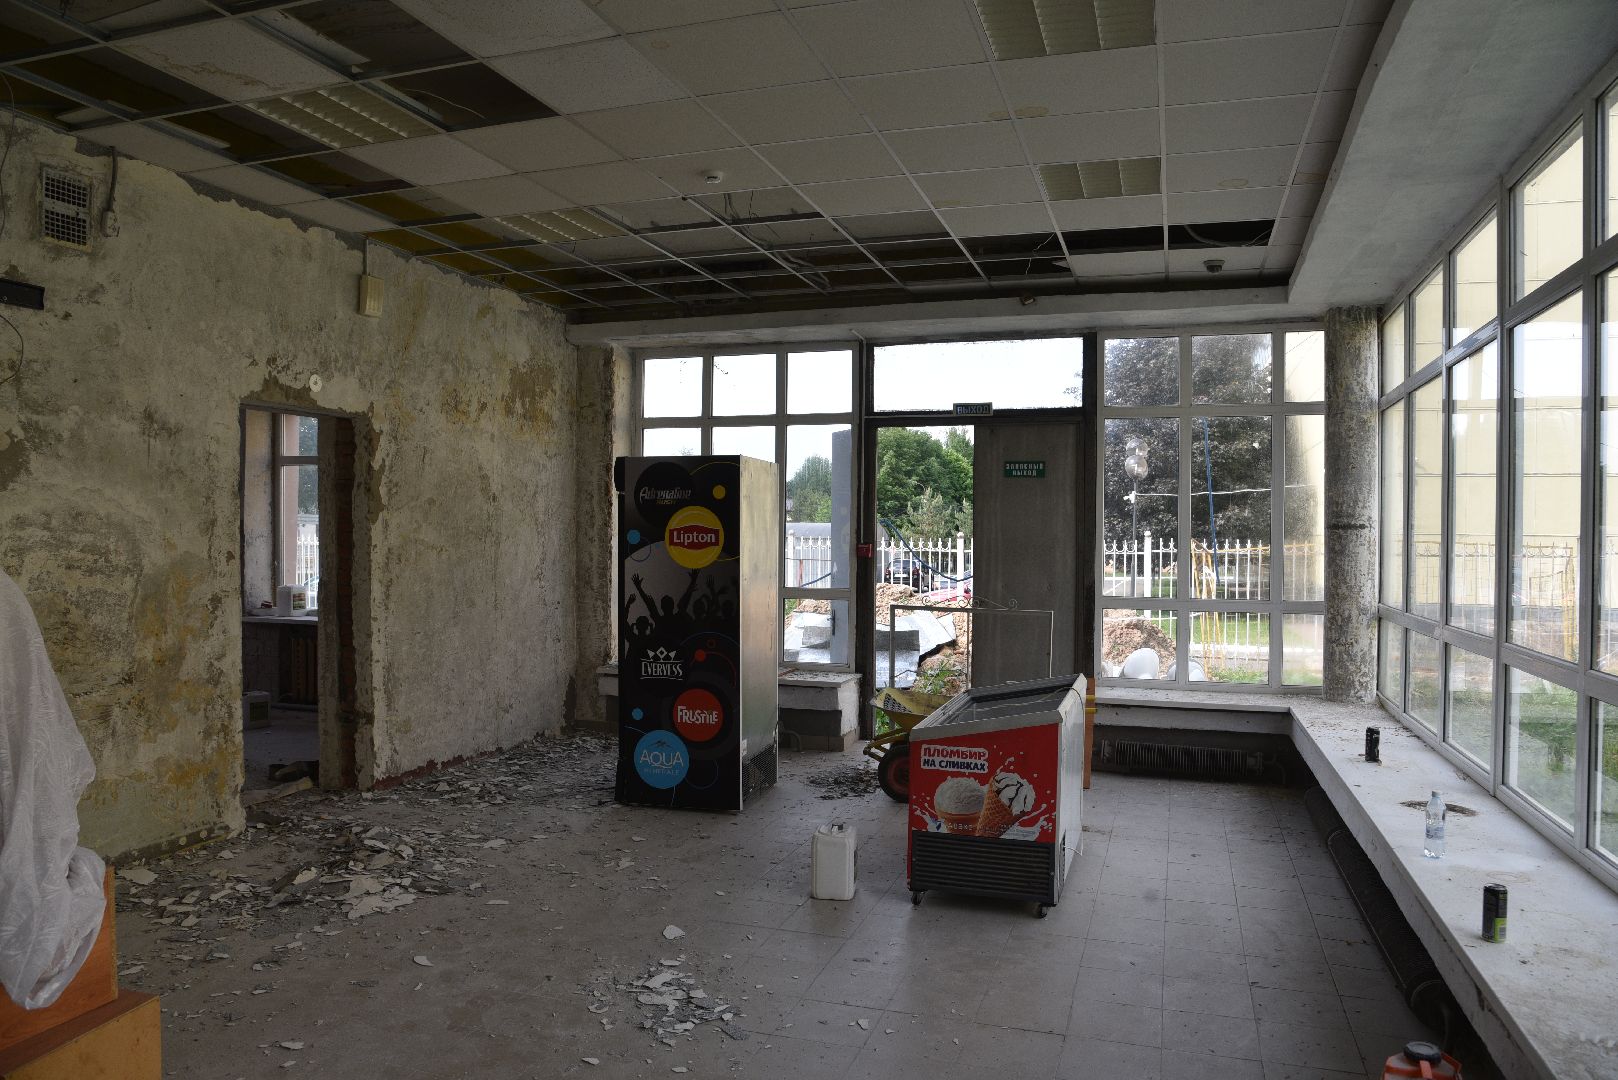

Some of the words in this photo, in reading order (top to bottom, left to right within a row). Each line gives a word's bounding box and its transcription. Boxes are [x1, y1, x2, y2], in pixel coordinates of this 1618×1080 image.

[957, 405, 990, 415] ВЫХОД
[674, 530, 716, 545] Lipton
[641, 662, 683, 677] EVERVESS
[639, 750, 684, 768] AQUA
[923, 747, 986, 760] ПЛОМБИР
[923, 758, 936, 768] НА
[939, 759, 986, 772] СЛИВКАХ
